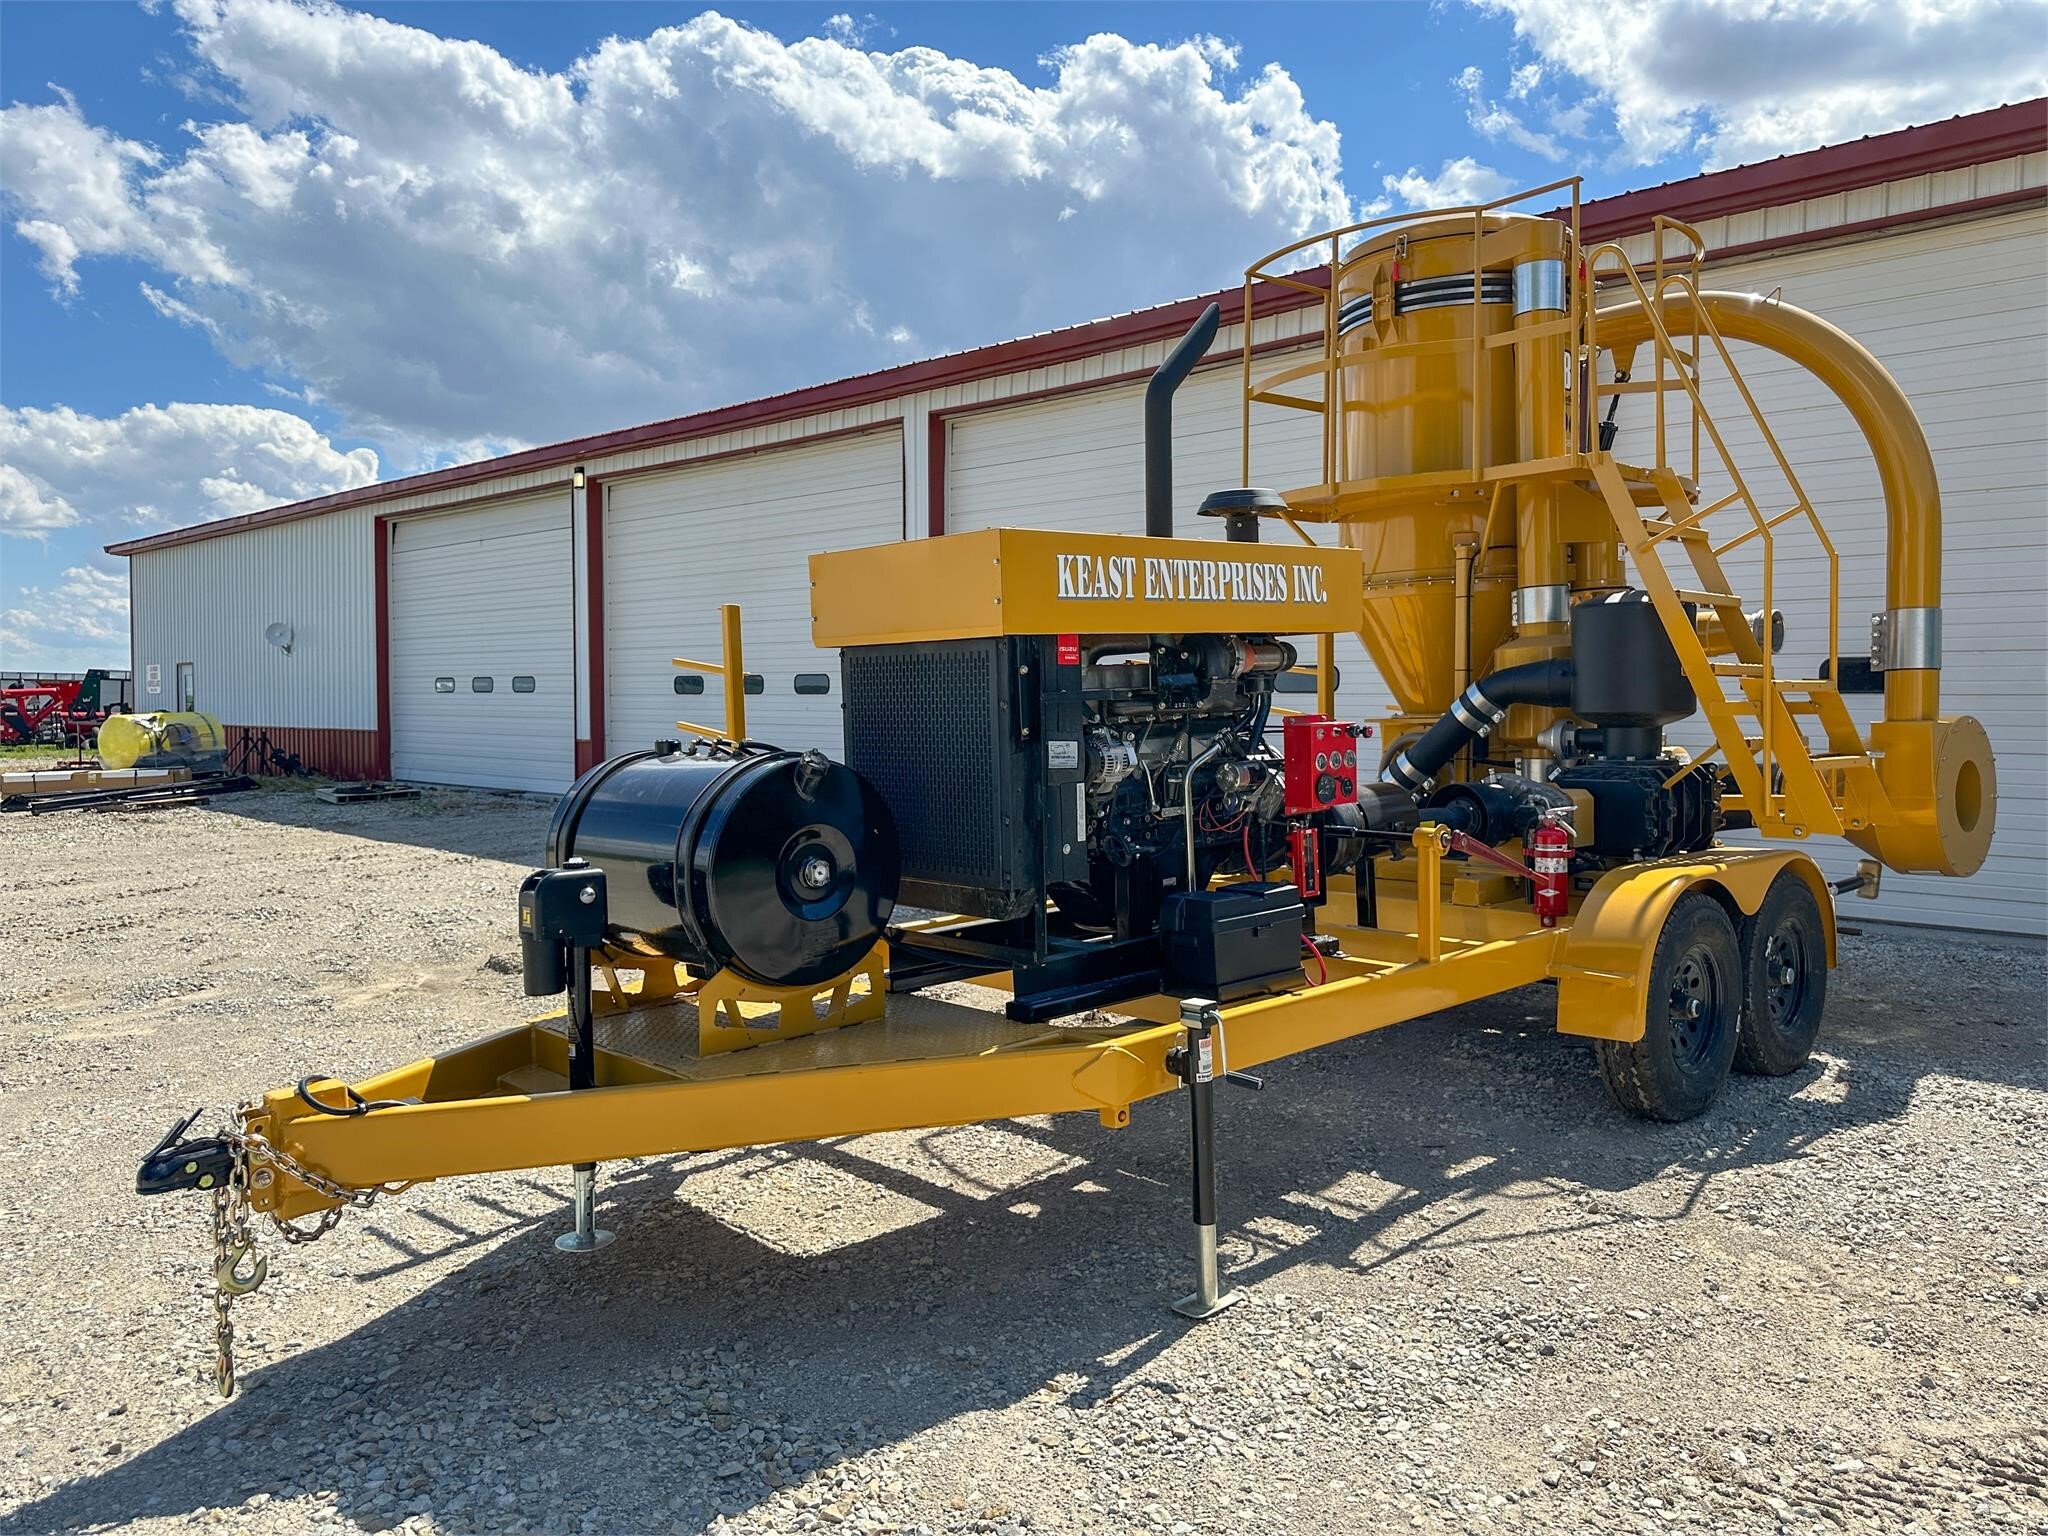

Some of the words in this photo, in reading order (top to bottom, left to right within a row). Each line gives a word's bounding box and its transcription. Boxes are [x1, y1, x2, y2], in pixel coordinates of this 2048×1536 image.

[1056, 554, 1137, 600] KEAST
[1143, 557, 1288, 603] ENTERPRISES
[1292, 564, 1328, 603] INC.
